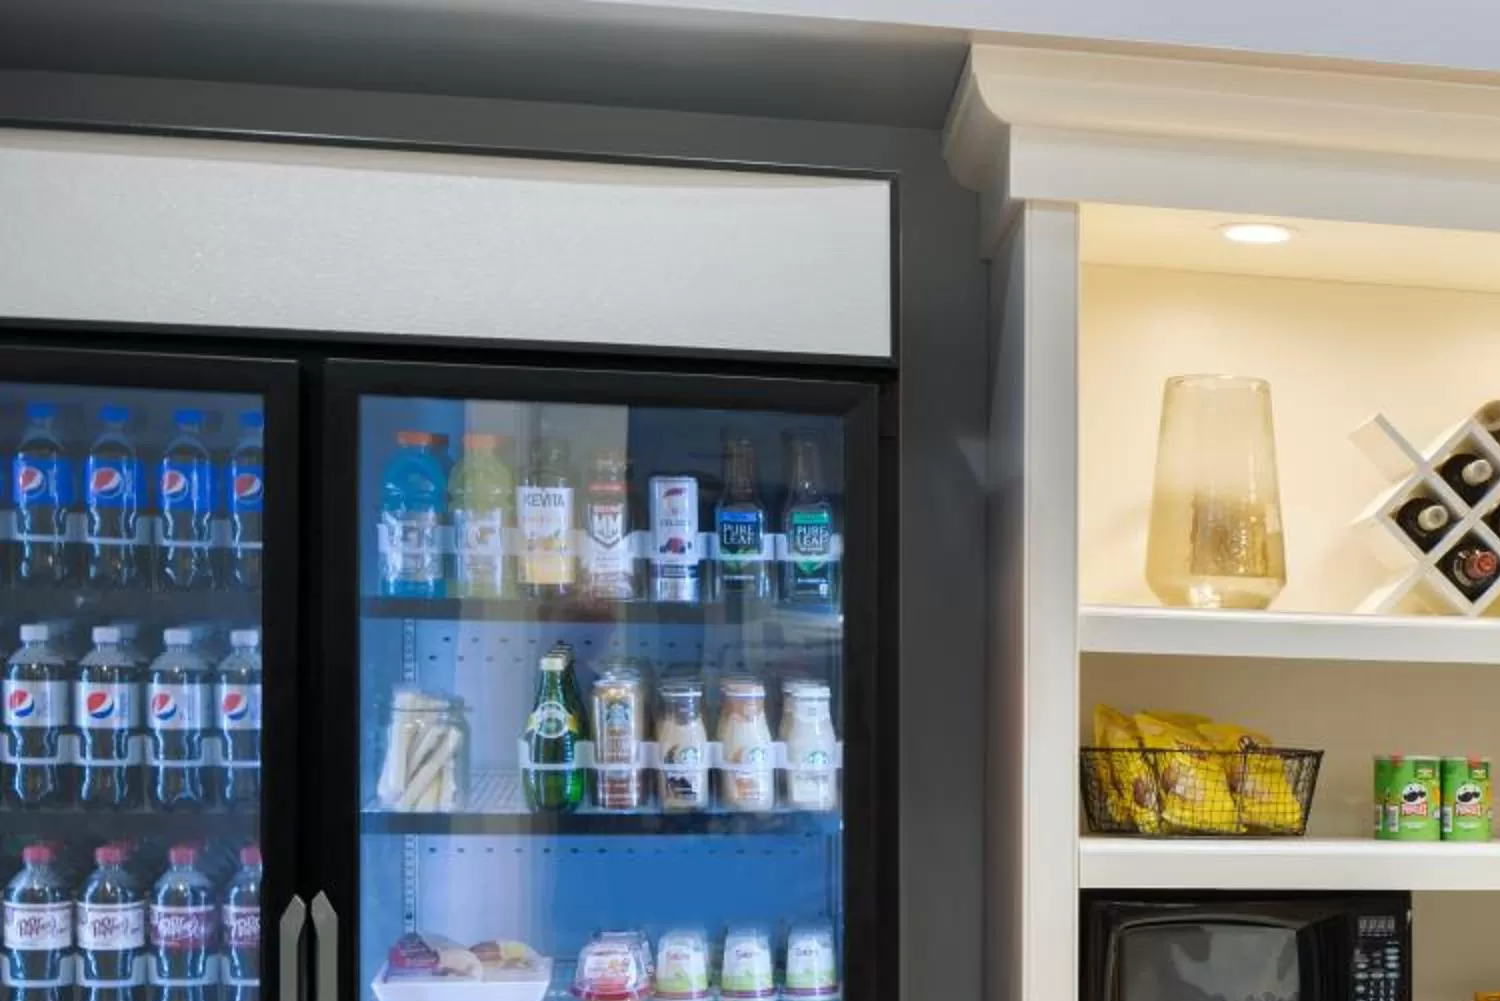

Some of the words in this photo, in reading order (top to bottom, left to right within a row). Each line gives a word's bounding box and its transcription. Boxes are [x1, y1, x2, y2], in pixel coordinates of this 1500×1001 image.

[723, 523, 753, 534] PURE
[797, 525, 829, 536] PURE
[723, 534, 753, 545] LEAF
[797, 536, 829, 547] LEAF
